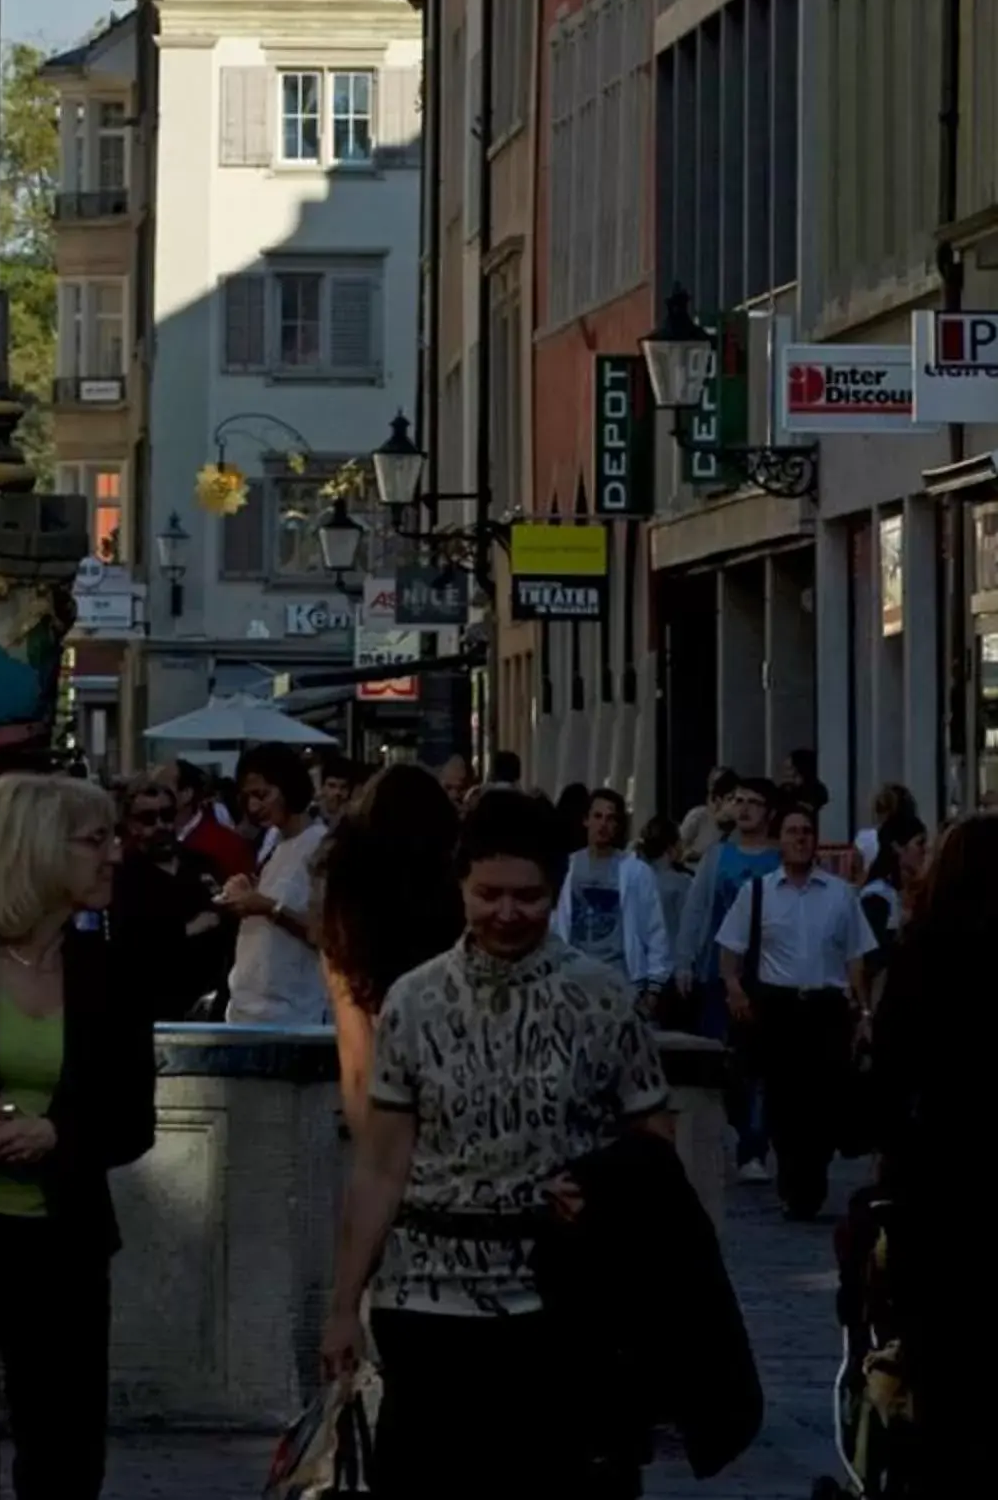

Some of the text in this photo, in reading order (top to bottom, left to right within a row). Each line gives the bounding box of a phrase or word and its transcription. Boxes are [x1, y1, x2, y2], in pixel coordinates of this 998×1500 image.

[825, 366, 888, 385] Inter
[603, 361, 627, 509] DEPOT
[518, 586, 600, 607] THEATER
